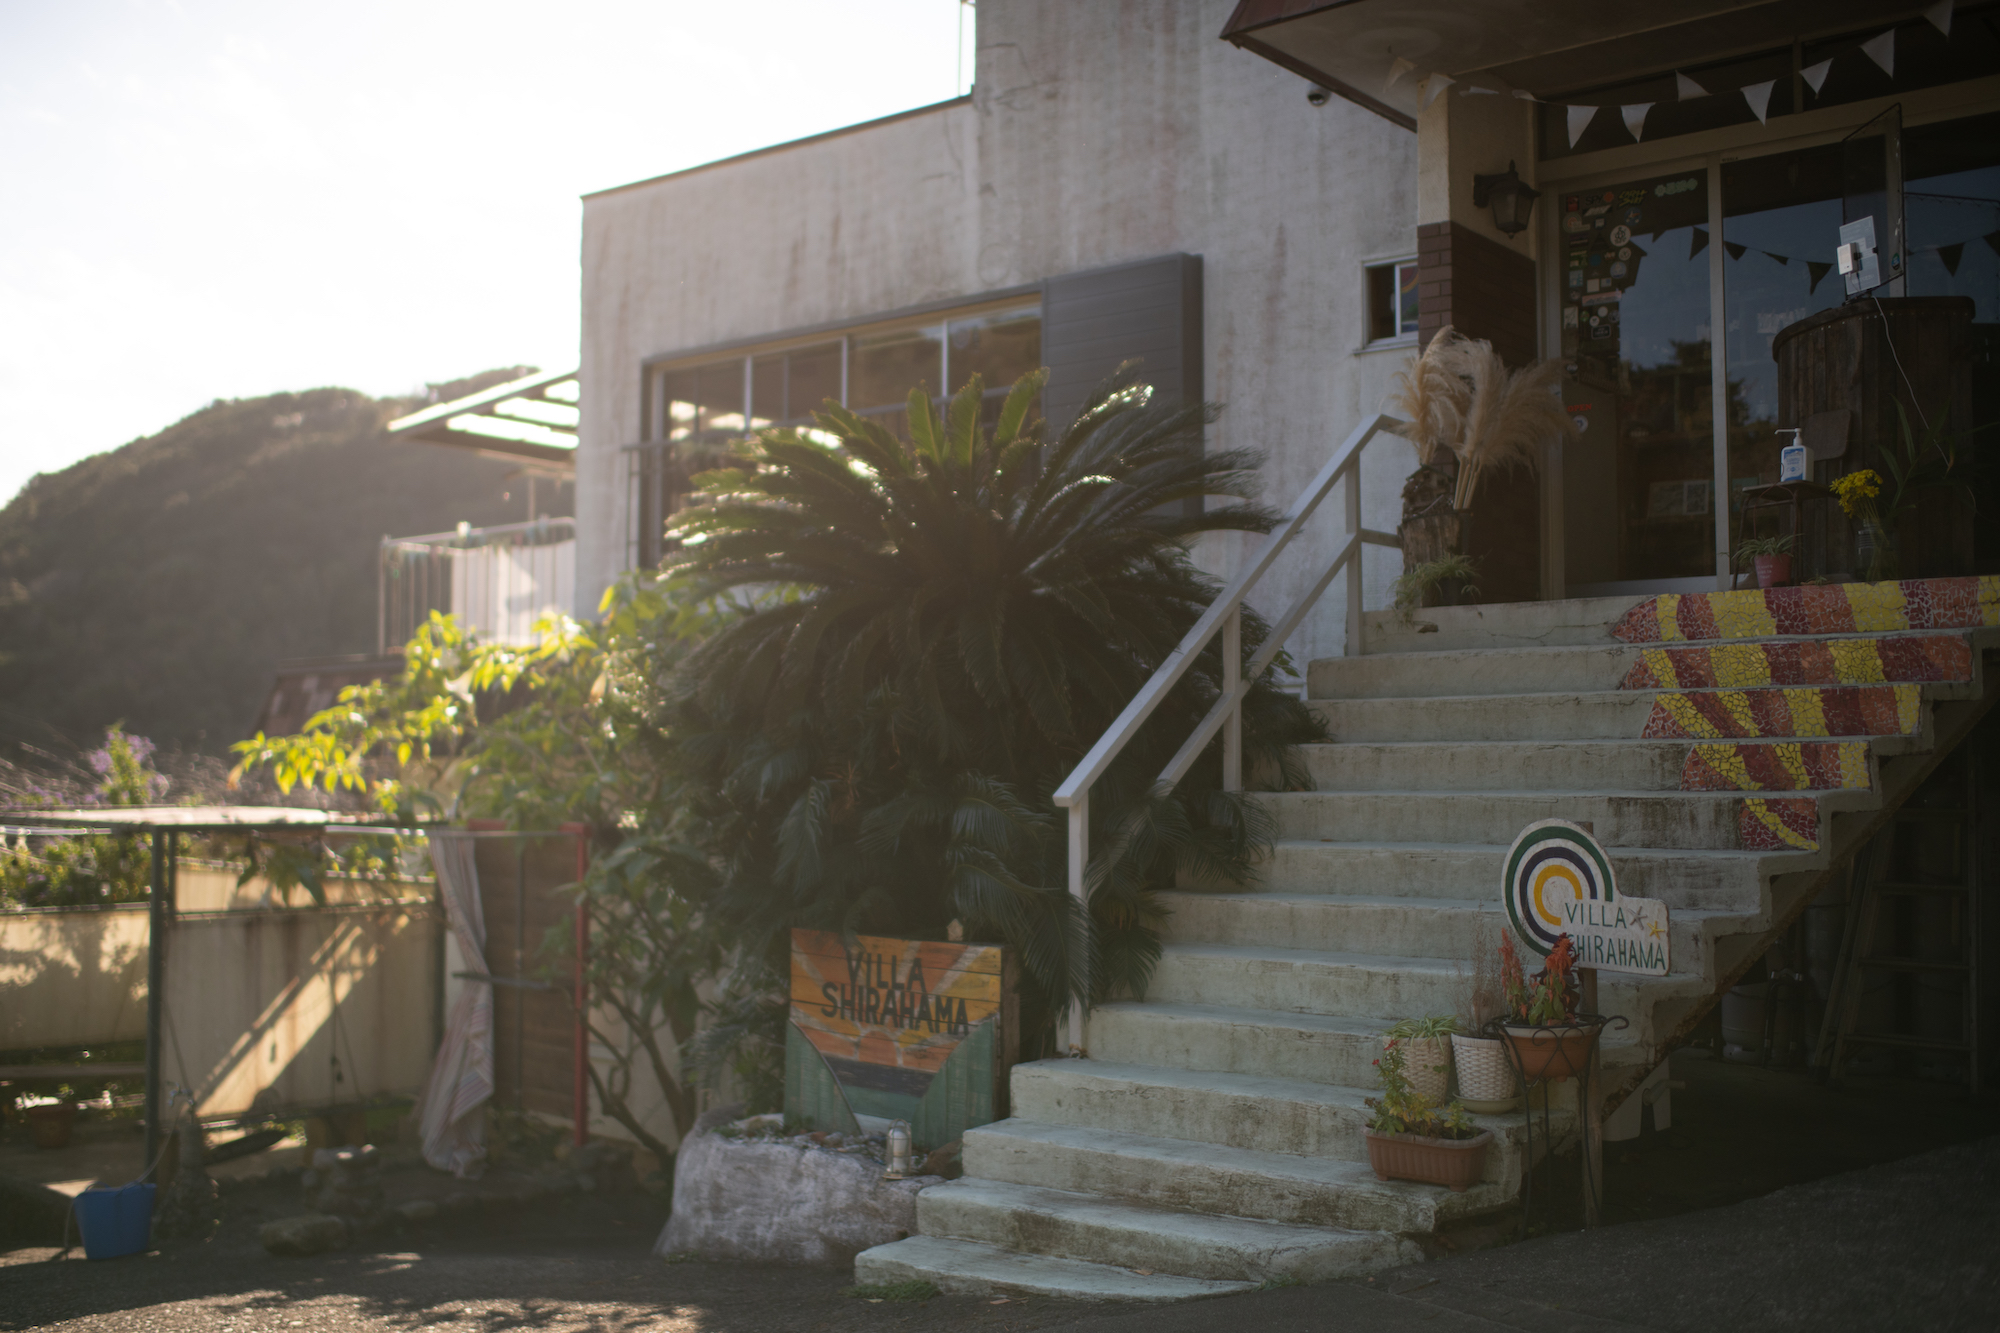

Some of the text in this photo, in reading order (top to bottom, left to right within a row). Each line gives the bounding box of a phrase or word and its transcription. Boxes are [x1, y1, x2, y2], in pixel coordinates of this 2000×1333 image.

[1567, 403, 1592, 412] OPEN
[1566, 902, 1627, 929] VILLA
[847, 953, 927, 994] VILLA
[822, 982, 970, 1035] SHIRAHAMA
